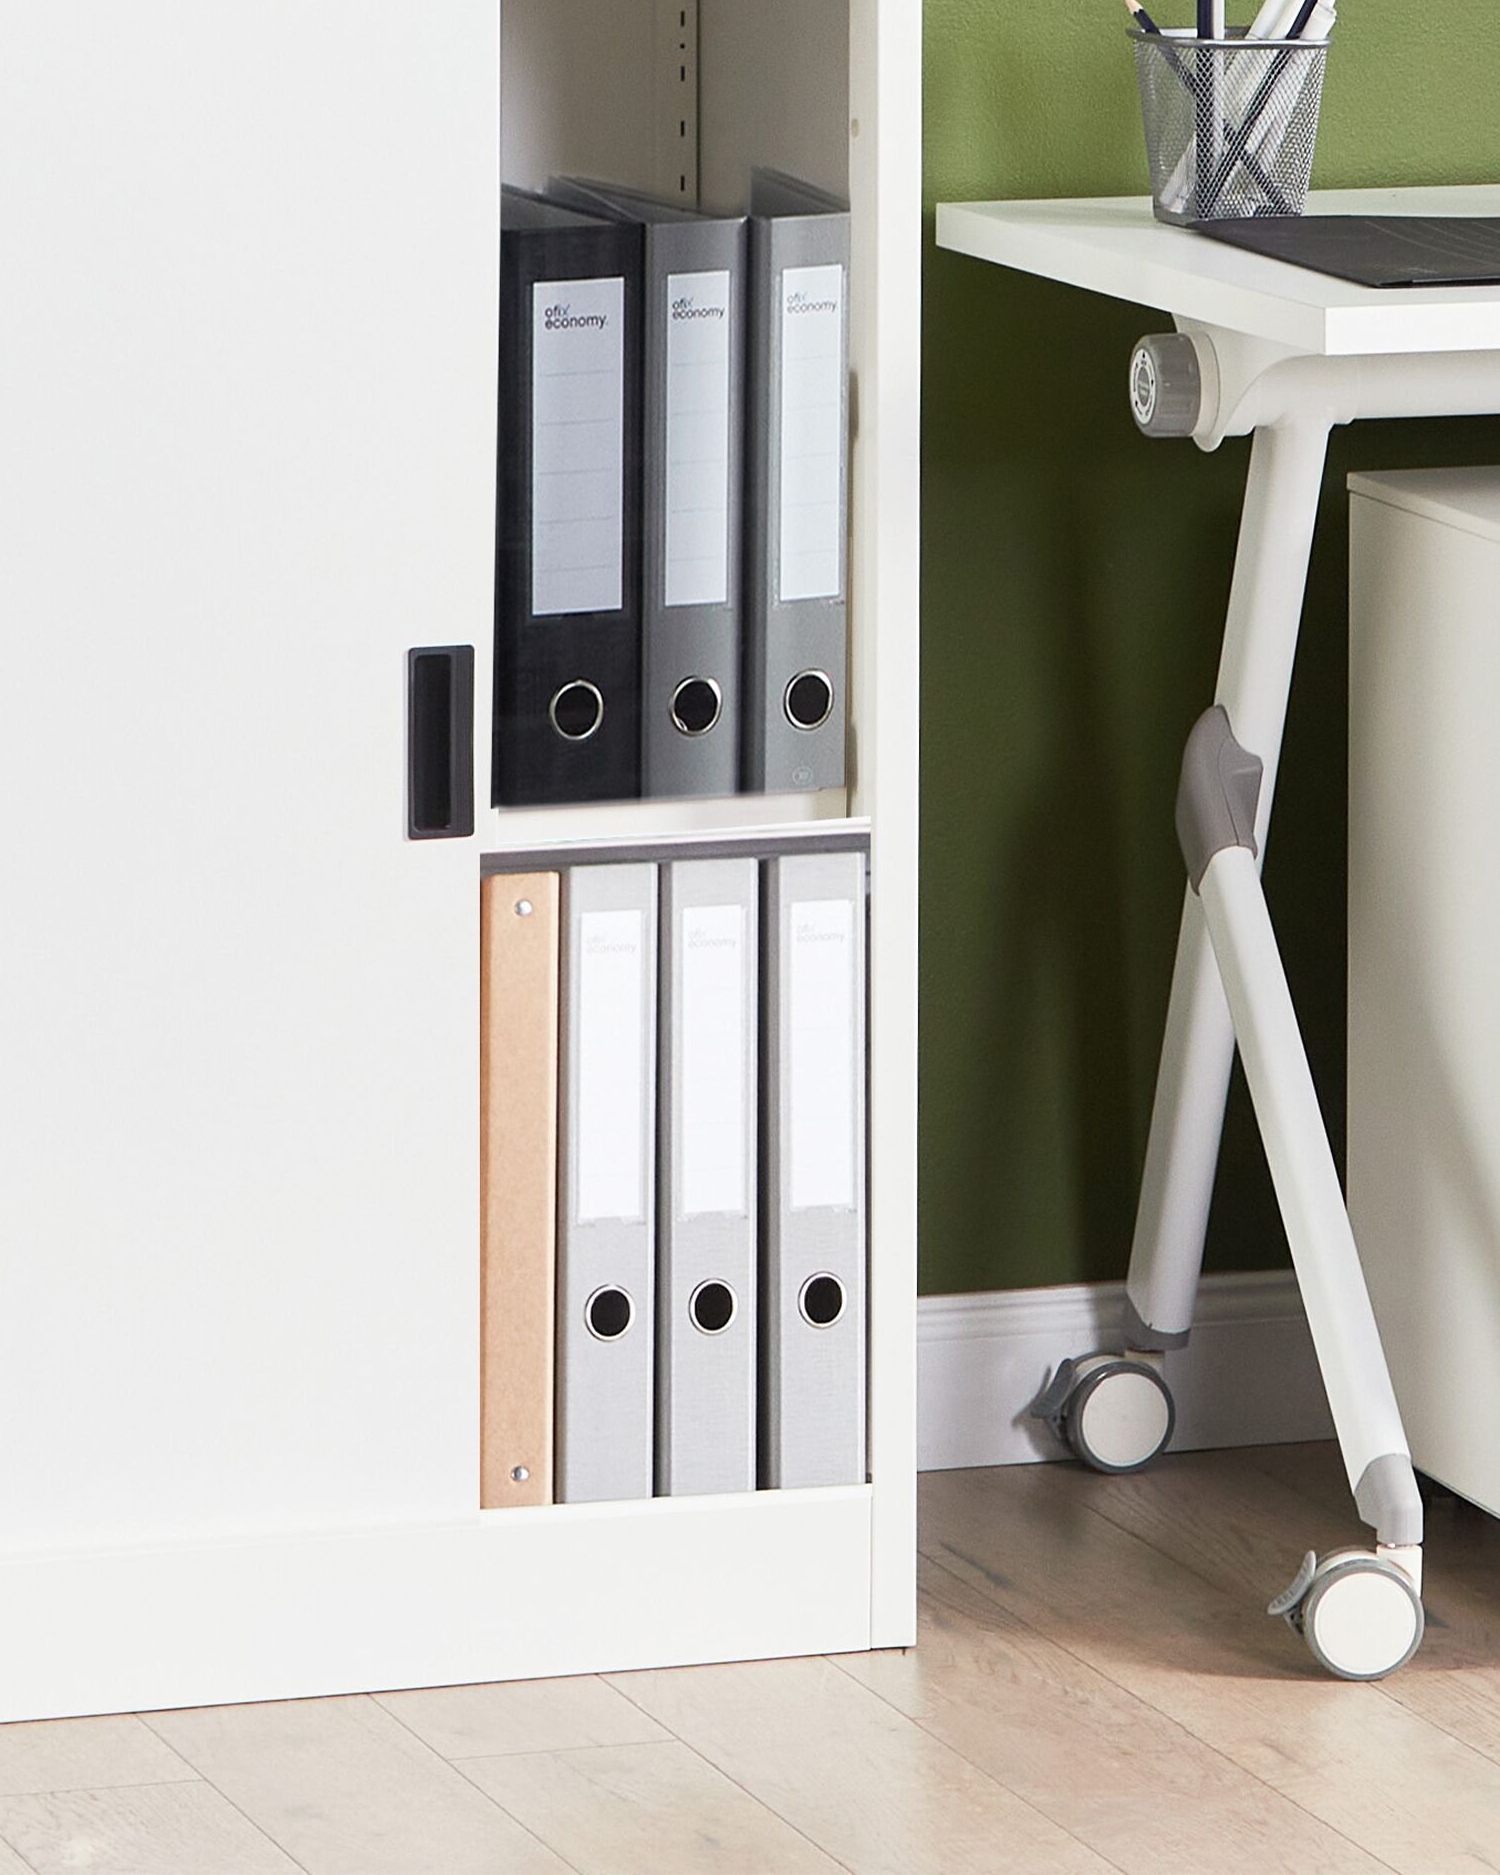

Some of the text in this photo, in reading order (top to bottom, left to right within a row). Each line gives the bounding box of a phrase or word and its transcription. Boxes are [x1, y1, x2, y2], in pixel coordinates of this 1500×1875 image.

[672, 306, 725, 321] economy
[787, 300, 837, 314] economy
[545, 315, 607, 330] economy
